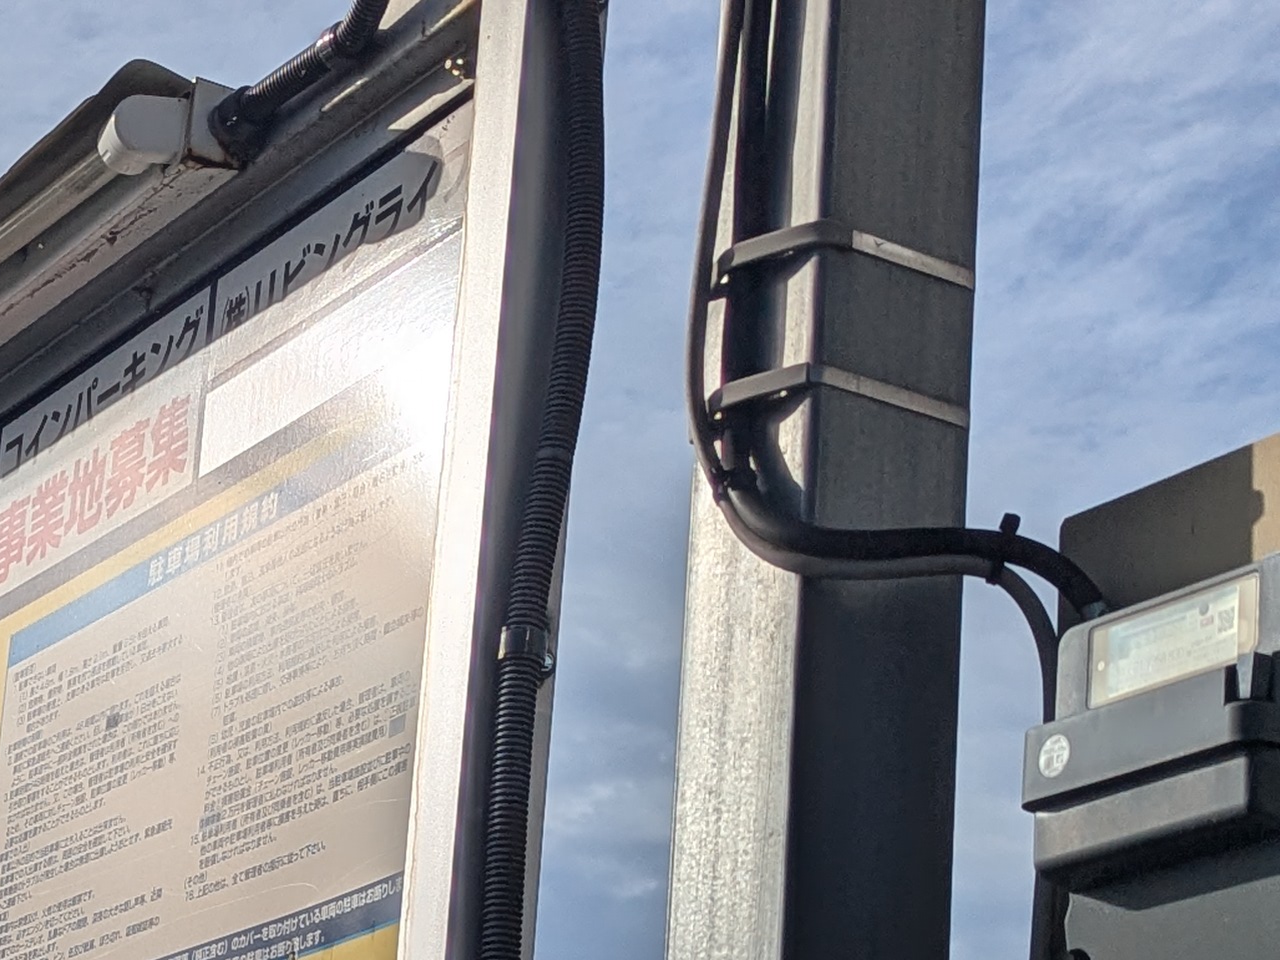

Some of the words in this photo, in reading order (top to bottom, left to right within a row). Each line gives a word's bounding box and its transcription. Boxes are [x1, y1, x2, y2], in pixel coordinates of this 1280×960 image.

[4, 305, 205, 471] コインパーキング
[147, 491, 279, 587] 駐車場利用規約
